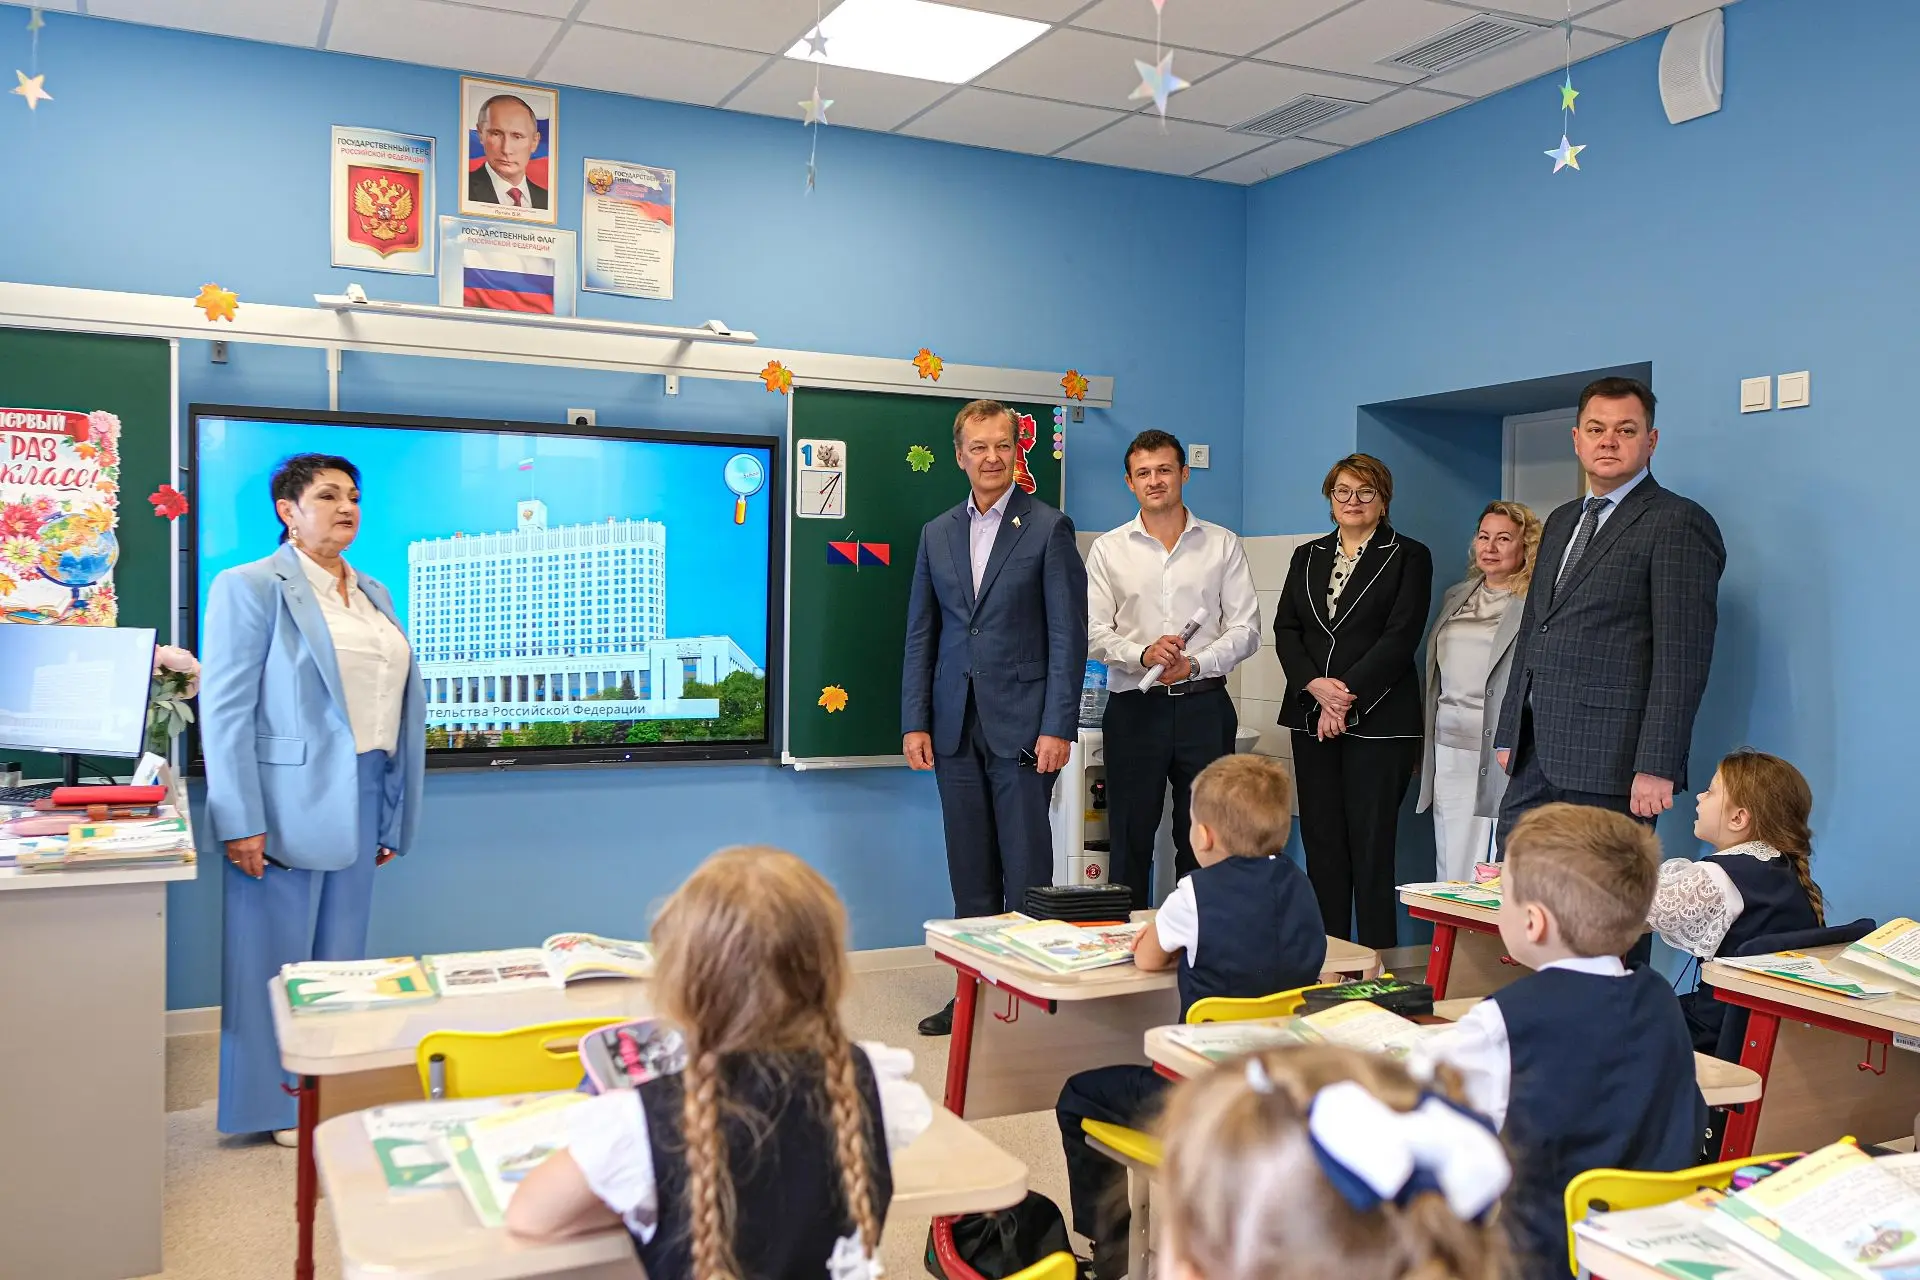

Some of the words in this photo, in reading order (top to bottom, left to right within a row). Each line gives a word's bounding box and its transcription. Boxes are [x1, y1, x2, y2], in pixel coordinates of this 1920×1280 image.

[337, 137, 410, 153] ГОСУДАРСТВЕННЫЙ
[411, 147, 430, 156] ГЕРБ
[341, 147, 385, 158] РОССИЙСКОЙ
[386, 153, 425, 164] ФЕДЕРАЦИИ
[614, 170, 671, 184] ГОСУДАРСТВЕН
[462, 227, 535, 242] ГОСУДАРСТВЕННЫЙ
[537, 236, 556, 244] ФЛАГ
[467, 236, 512, 247] РОССИЙСКОЙ
[512, 242, 550, 252] ФЕДЕРАЦИИ
[11, 435, 57, 462] РАЗ
[800, 444, 812, 467] 1
[428, 708, 488, 718] тельства
[493, 705, 569, 717] Российской
[573, 704, 646, 718] Федерации
